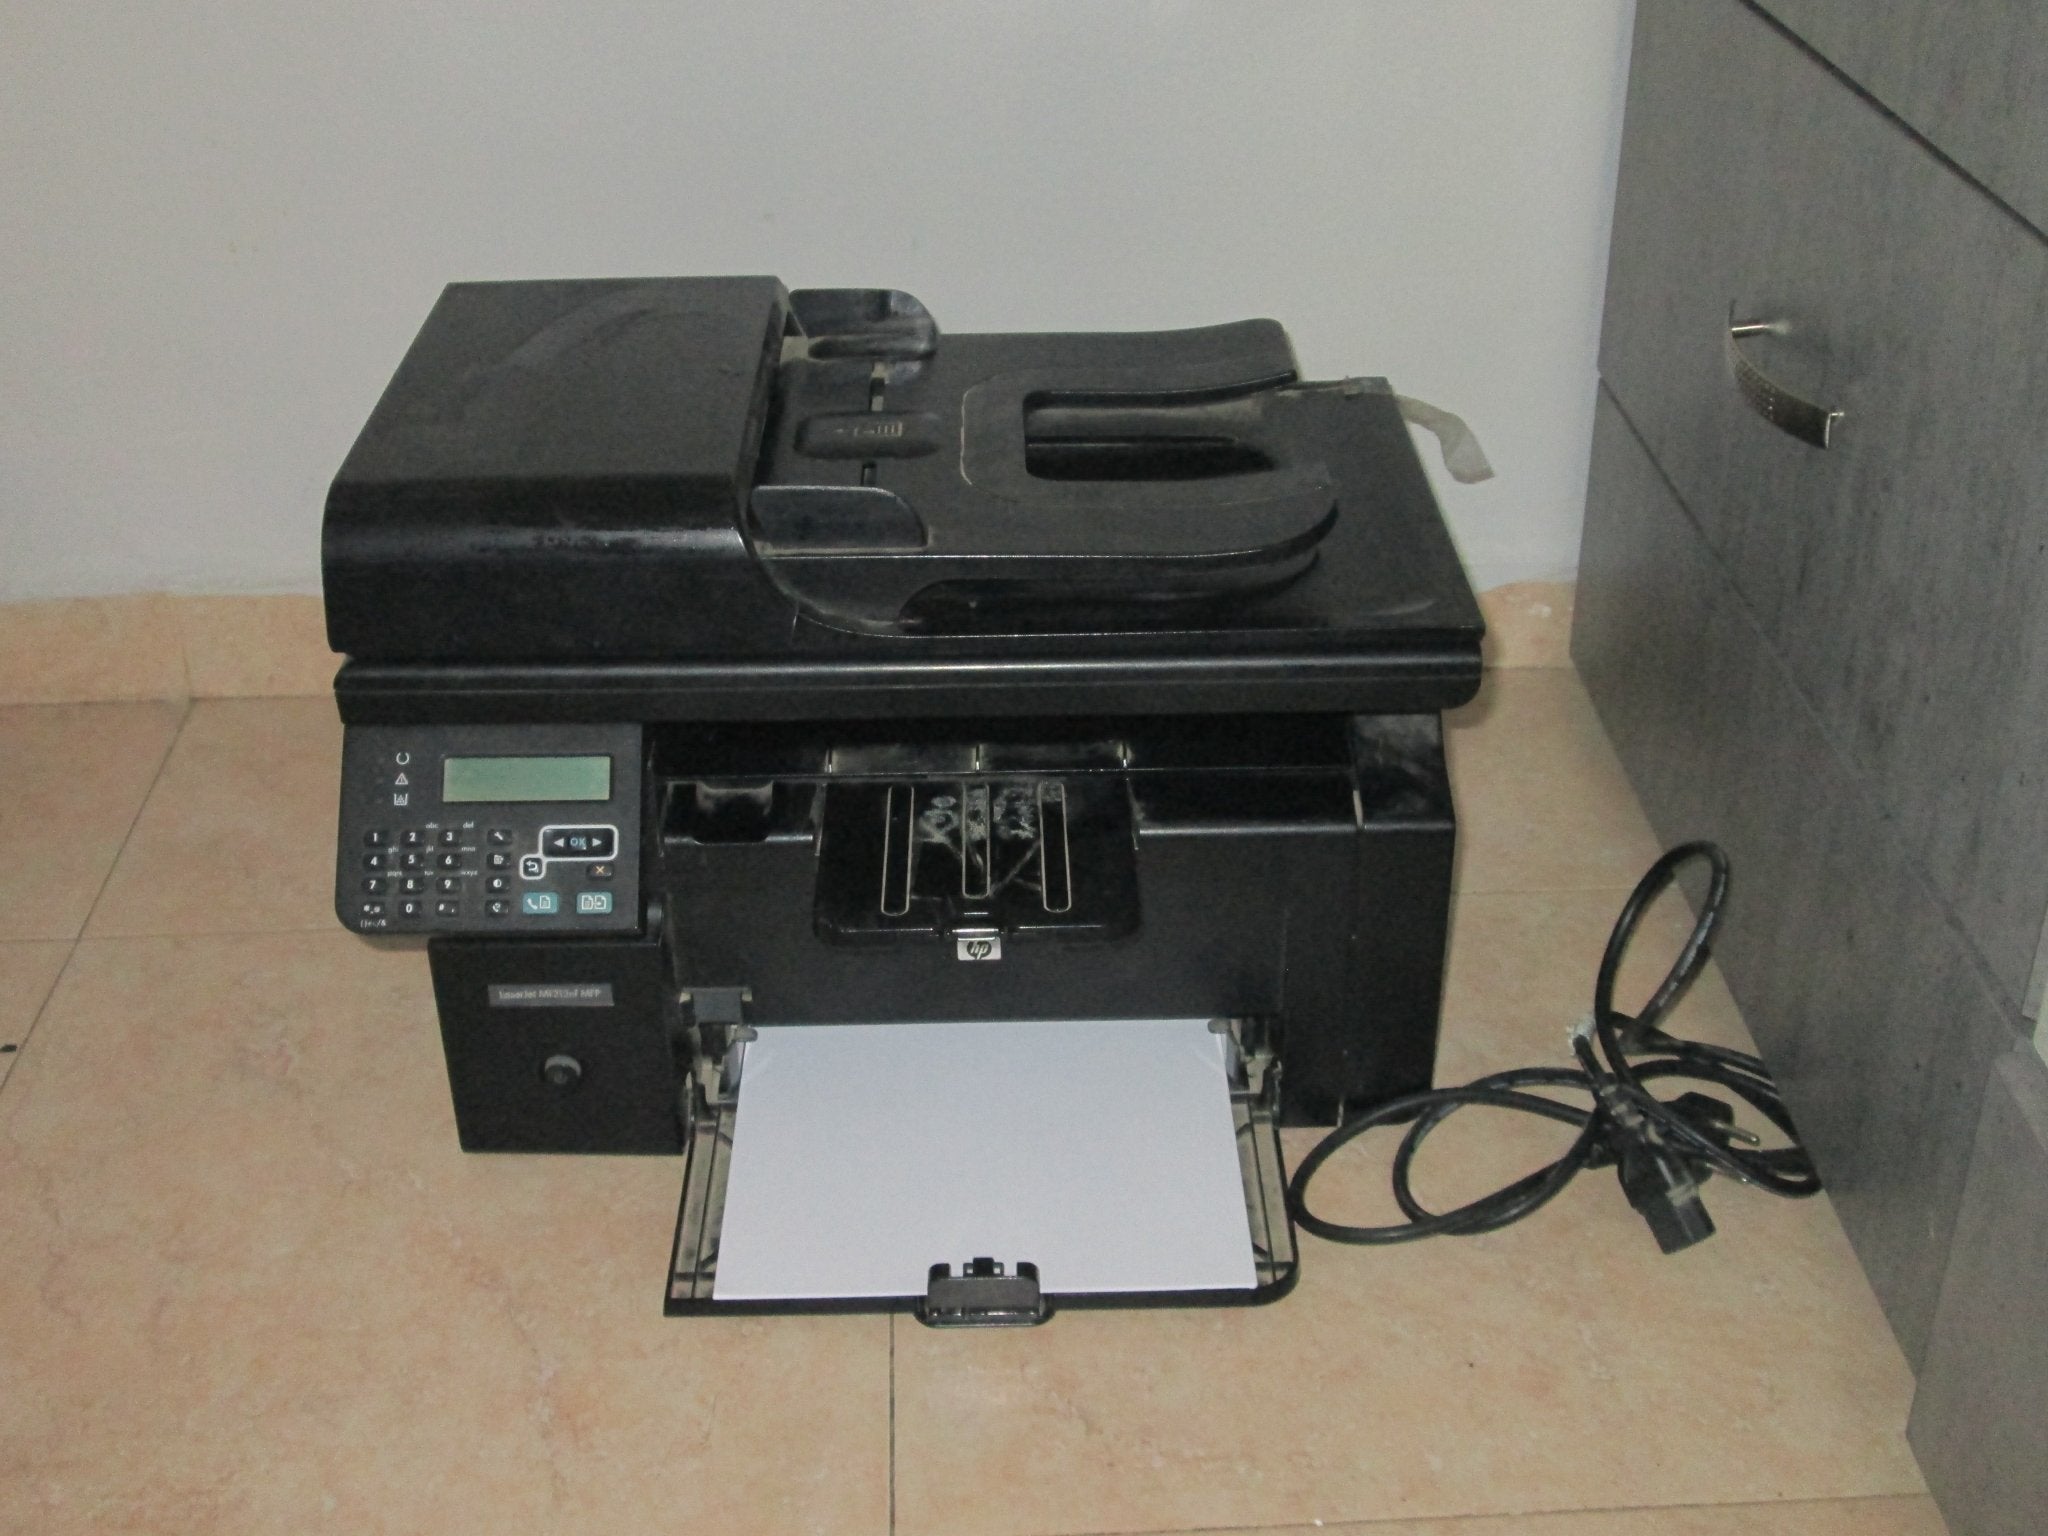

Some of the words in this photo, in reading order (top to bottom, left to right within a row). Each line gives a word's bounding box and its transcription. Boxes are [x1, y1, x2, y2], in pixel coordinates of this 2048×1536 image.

[372, 832, 378, 842] 1
[409, 832, 416, 842] 2
[446, 831, 453, 841] 3
[570, 837, 586, 847] OK
[370, 856, 378, 866] 4
[408, 854, 415, 864] 5
[445, 856, 452, 865] 6
[369, 880, 376, 890] 7
[406, 879, 414, 889] 8
[444, 879, 451, 889] 9
[405, 903, 413, 913] 0
[967, 940, 991, 960] hp
[498, 989, 537, 999] LaserJet
